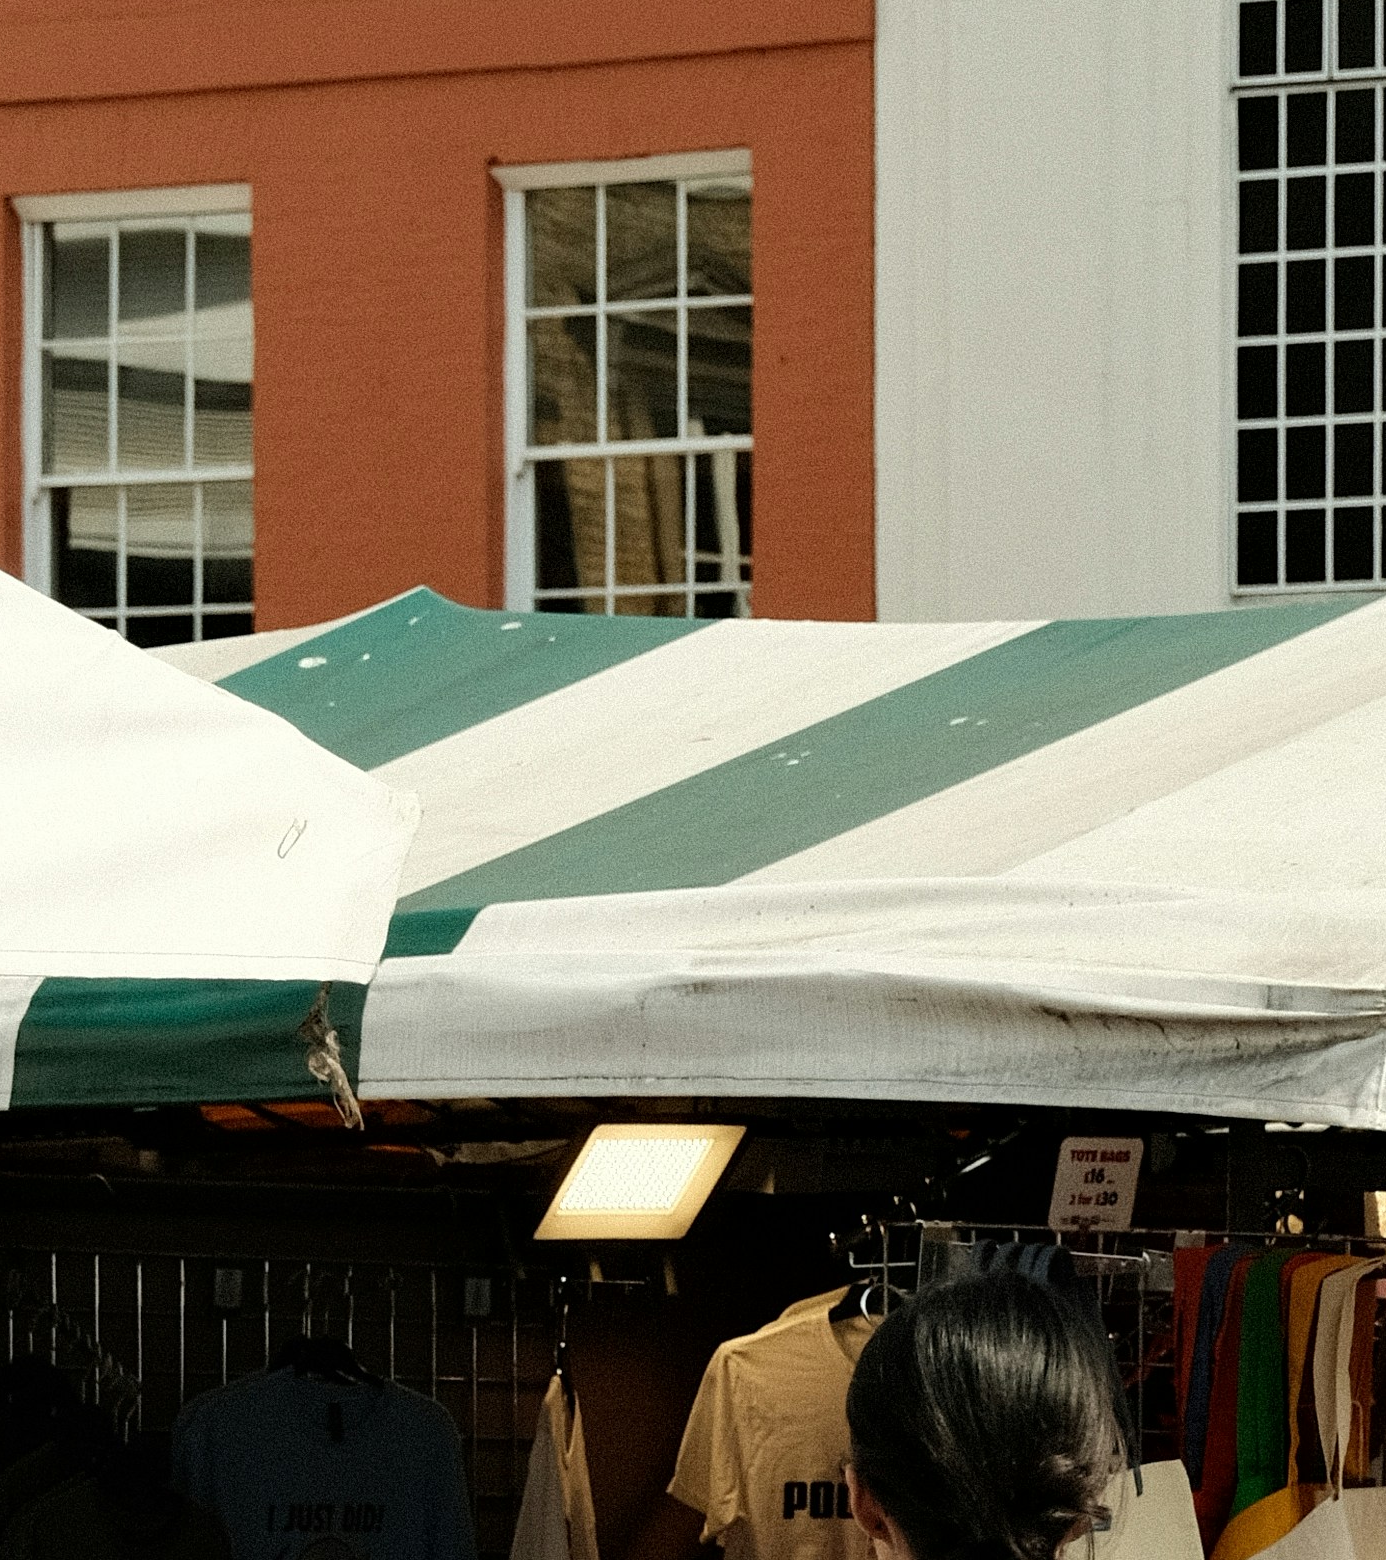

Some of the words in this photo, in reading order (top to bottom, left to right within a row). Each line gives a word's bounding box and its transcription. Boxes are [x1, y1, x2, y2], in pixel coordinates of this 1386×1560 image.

[1071, 1150, 1097, 1162] TOTE
[1100, 1150, 1131, 1162] BAGS
[268, 1504, 275, 1531] I
[283, 1503, 334, 1532] JUST
[342, 1504, 385, 1533] DID!
